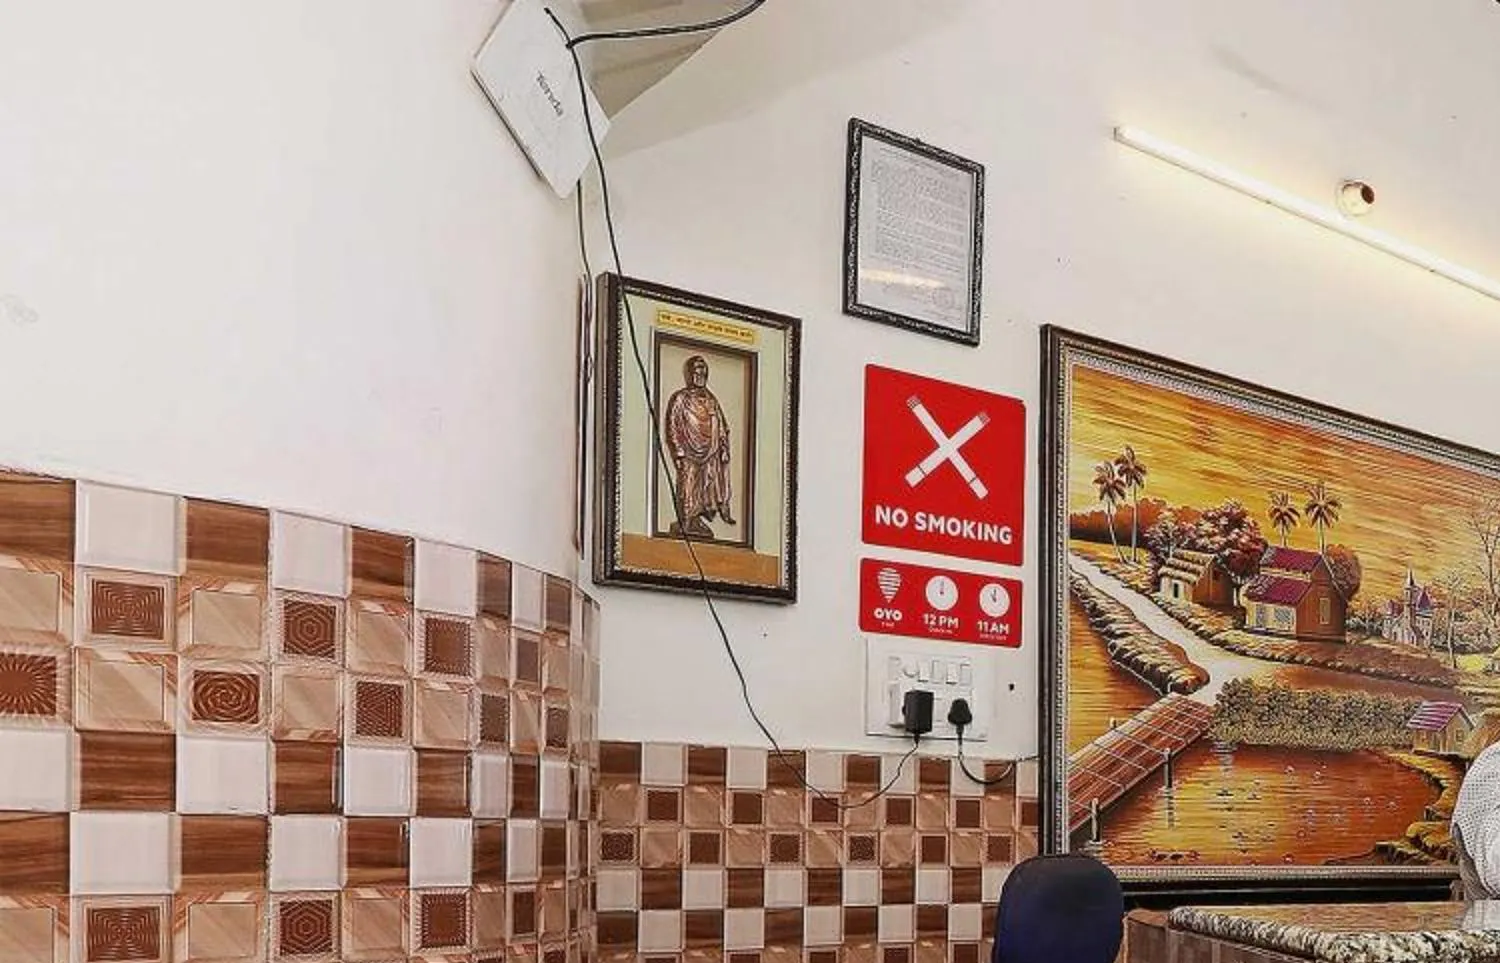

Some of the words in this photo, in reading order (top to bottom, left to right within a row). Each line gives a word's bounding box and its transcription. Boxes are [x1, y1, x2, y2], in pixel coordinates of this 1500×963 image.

[875, 504, 908, 528] NO
[914, 511, 1012, 544] SMOKING
[874, 607, 903, 621] OYO
[923, 613, 937, 625] 12
[938, 616, 959, 629] PM
